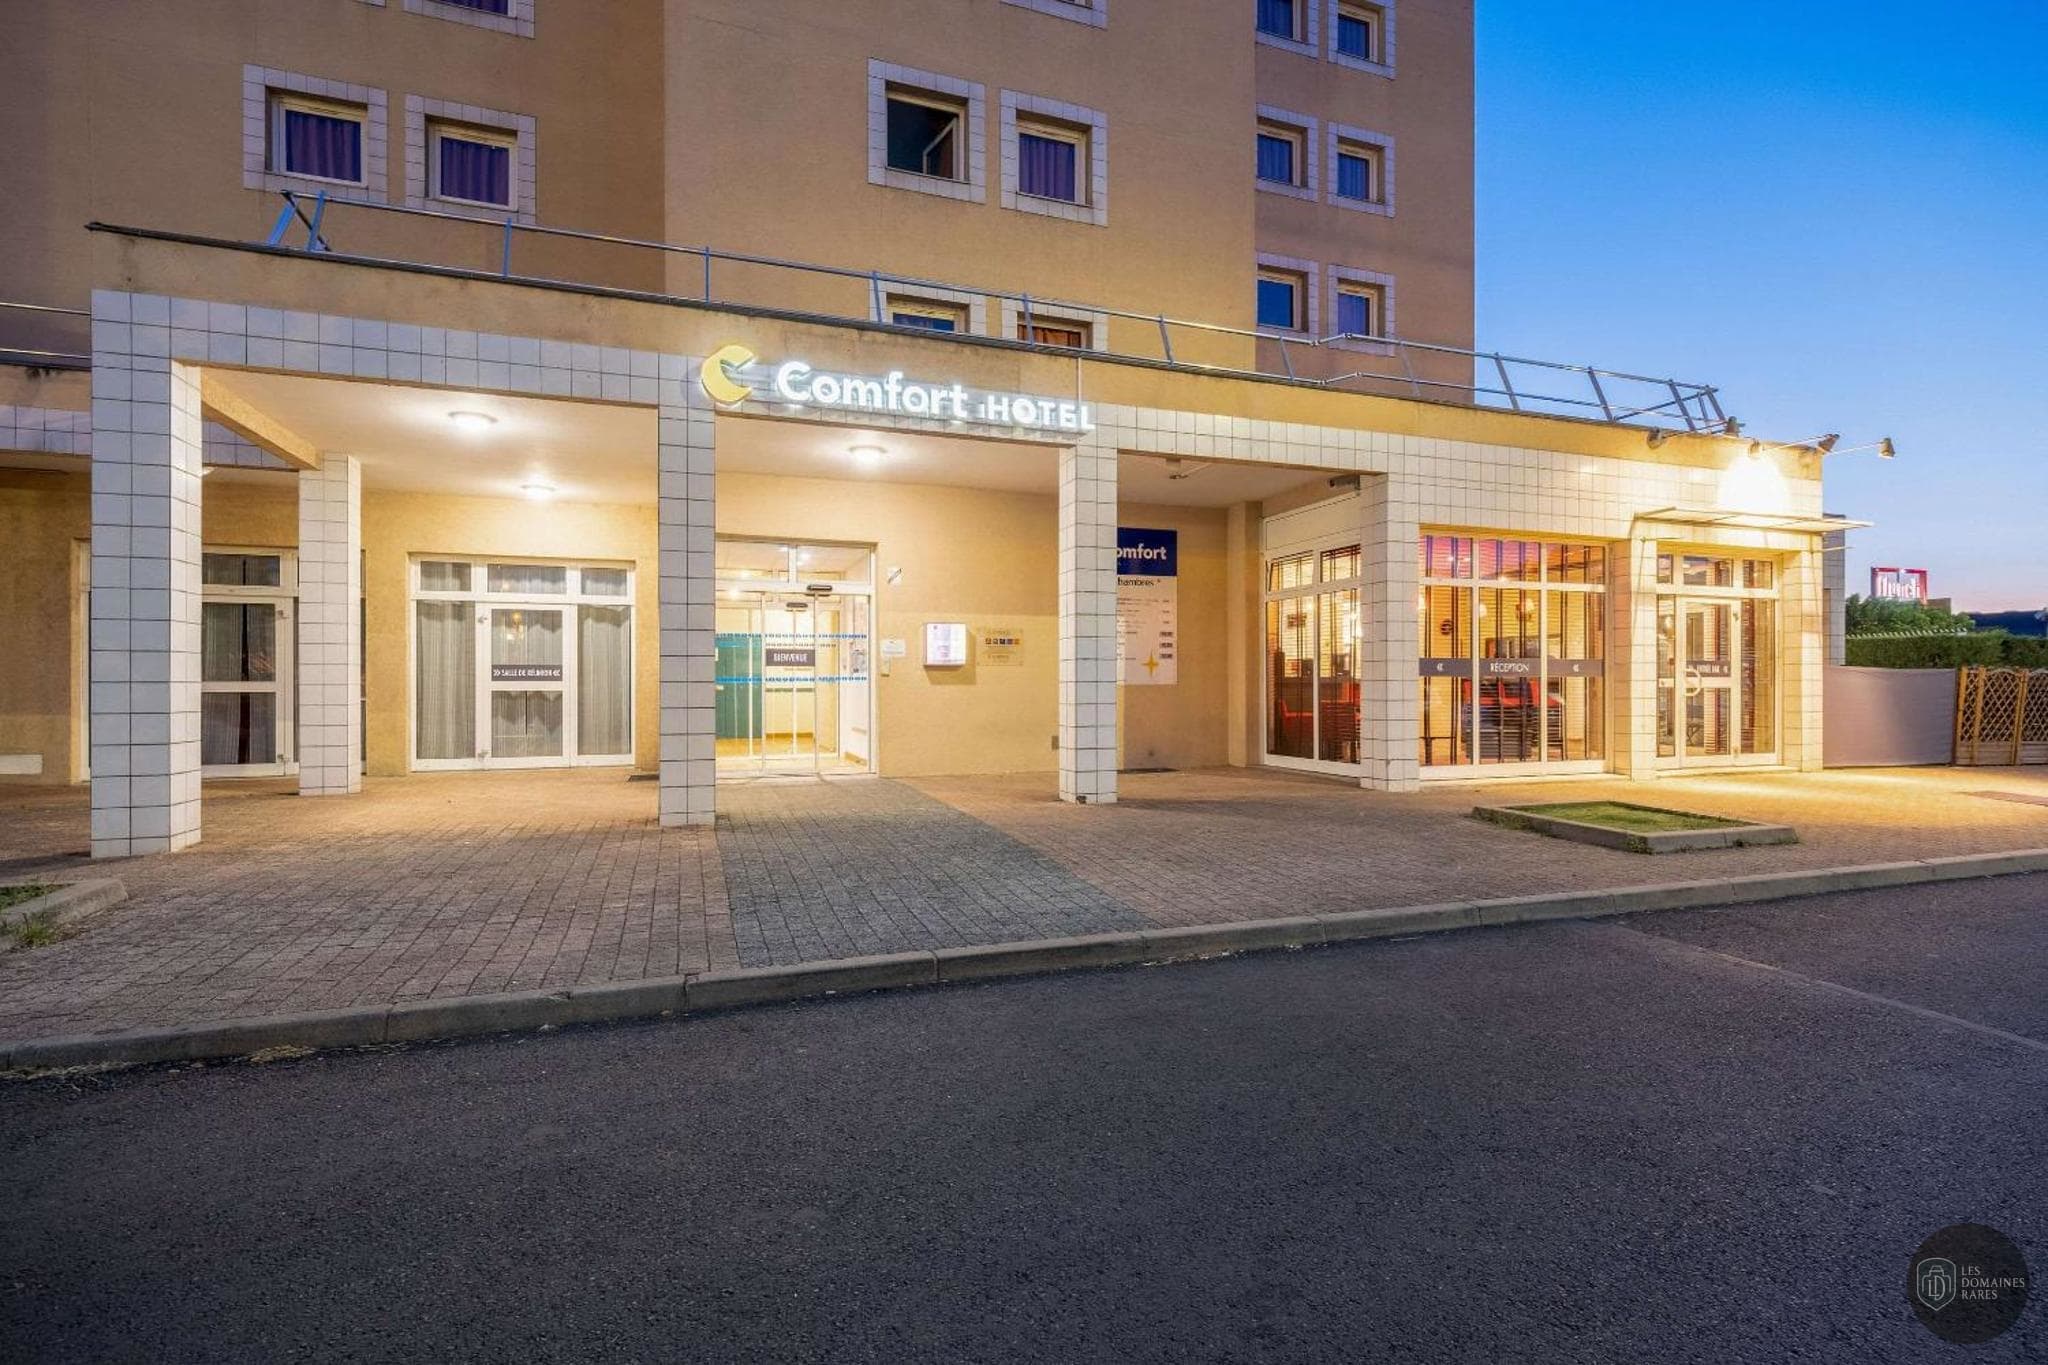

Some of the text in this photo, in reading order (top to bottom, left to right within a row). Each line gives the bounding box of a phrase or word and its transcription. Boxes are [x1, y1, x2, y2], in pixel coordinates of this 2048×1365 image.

[777, 361, 1096, 430] Comfort HOTEL
[1117, 543, 1167, 560] omfort
[1118, 577, 1155, 586] hambres
